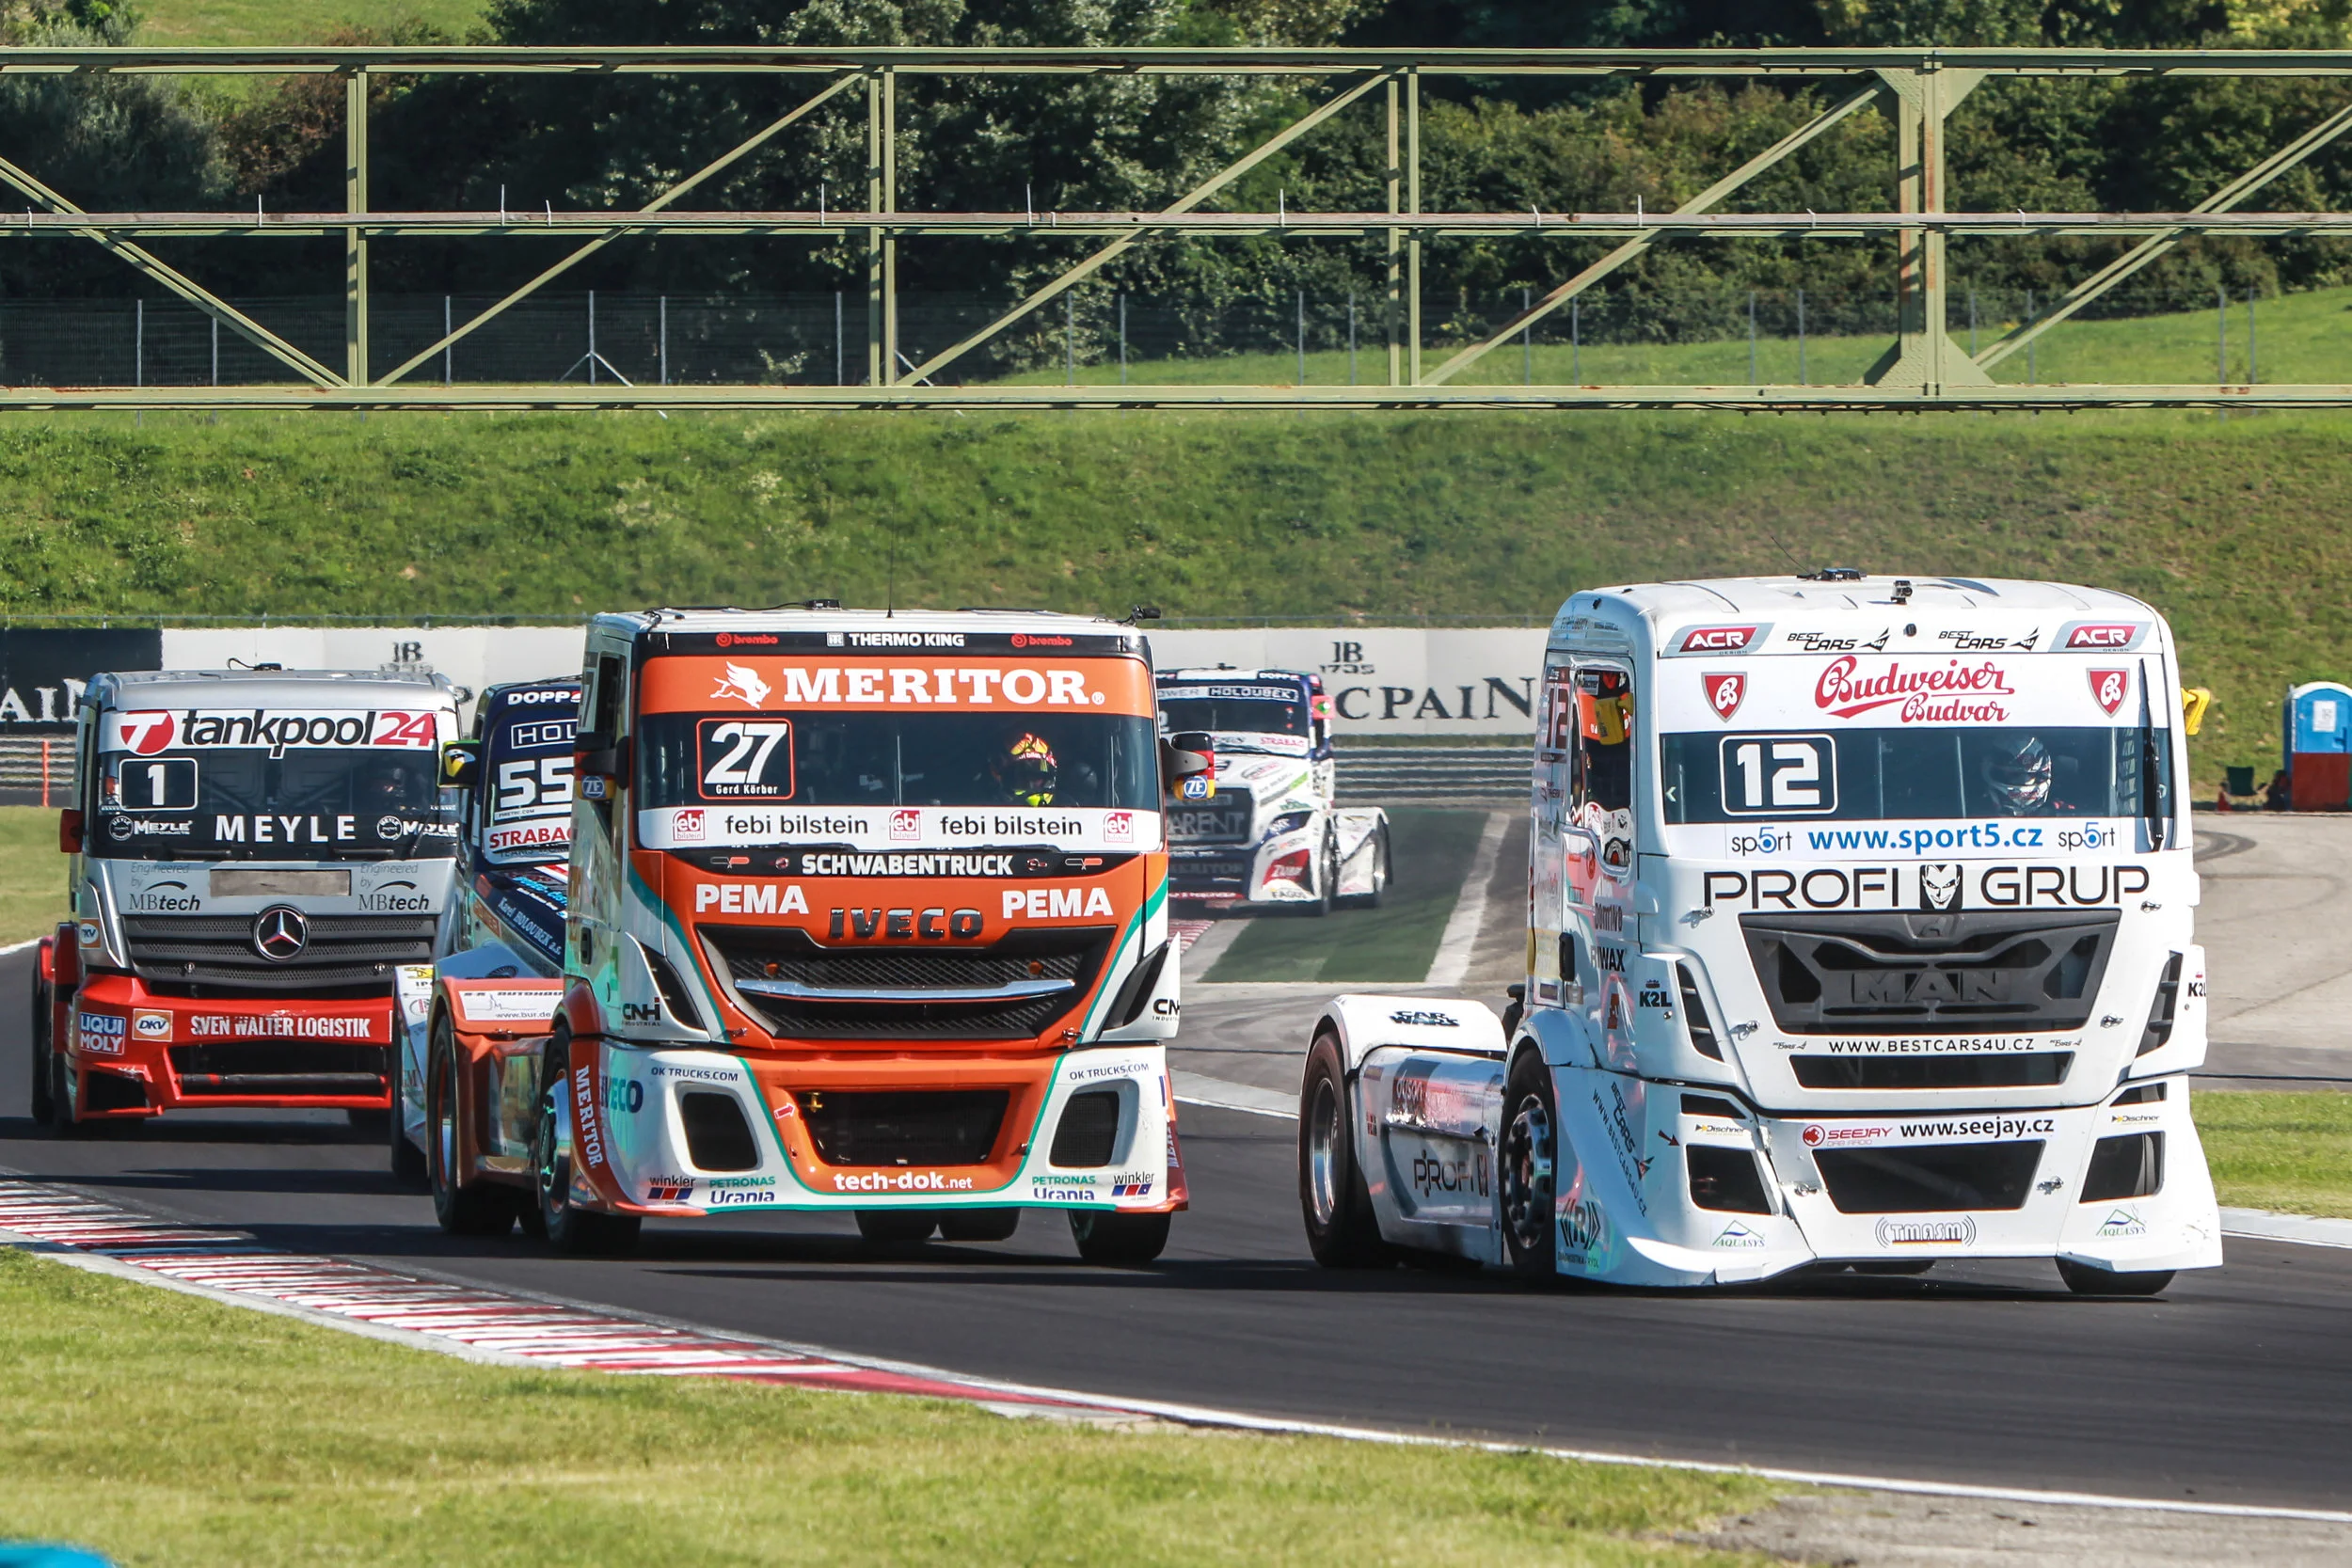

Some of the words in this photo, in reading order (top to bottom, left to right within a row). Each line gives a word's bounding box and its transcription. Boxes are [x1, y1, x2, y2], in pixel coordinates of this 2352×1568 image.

[734, 634, 779, 644] brembo
[849, 633, 921, 646] THERMO
[925, 633, 965, 647] KING
[1028, 636, 1073, 646] brembo
[1690, 631, 1744, 648] ACR
[1787, 632, 1823, 641] BEST
[1938, 631, 1974, 640] BEST
[1955, 638, 2008, 649] CARS
[2074, 629, 2126, 644] ACR
[1804, 640, 1858, 651] CARS
[783, 668, 1089, 705] MERITOR
[1815, 656, 2014, 707] Budweiser
[1210, 688, 1291, 699] HOLOUBEK
[1331, 677, 1535, 721] CPAIN
[1901, 692, 2010, 722] Budvar
[705, 722, 787, 784] 27
[500, 756, 574, 808] 55
[1737, 743, 1820, 807] 12
[147, 764, 165, 805] 1
[716, 784, 739, 795] Gerd
[1185, 778, 1206, 797] ZF
[134, 820, 191, 835] MEYLE
[215, 815, 357, 843] MEYLE
[725, 816, 771, 834] febi
[781, 816, 868, 834] bilstein
[940, 816, 986, 835] febi
[995, 815, 1083, 835] bilstein
[1808, 823, 2042, 855] www.sport5.cz
[131, 863, 188, 876] Engineered
[360, 863, 419, 876] Engineered
[802, 854, 1013, 876] SCHWABENTRUCK
[131, 878, 143, 889] by
[360, 877, 373, 889] by
[1704, 868, 1899, 910] PROFI
[1980, 865, 2150, 905] GRUP
[129, 892, 200, 911] MBtech
[358, 894, 430, 911] MBtech
[696, 884, 809, 914] PEMA
[1002, 887, 1113, 919] PEMA
[830, 908, 983, 939] IVECO
[1851, 971, 2010, 1003] MAN
[1640, 991, 1672, 1007] K2L
[80, 1014, 123, 1035] LIQUI
[138, 1021, 167, 1030] DKV
[191, 1015, 230, 1036] SVEN
[234, 1016, 294, 1037] WALTER
[297, 1017, 370, 1038] LOGISTIK
[80, 1034, 123, 1053] MOLY
[1829, 1037, 2034, 1053] WWW.BESTCARS4U.CZ
[651, 1067, 665, 1076] OK
[668, 1068, 739, 1081] TRUCKS.COM
[1070, 1070, 1085, 1080] OK
[1089, 1063, 1150, 1078] TRUCKS.COM
[576, 1065, 603, 1166] MERITOR
[1828, 1128, 1893, 1139] SEEJAY
[1900, 1117, 2055, 1139] www.seejay.cz
[650, 1176, 695, 1189] winkler
[709, 1176, 776, 1189] PETRONAS
[834, 1171, 973, 1190] tech-dok.net
[1032, 1175, 1096, 1185] PETRONAS
[1114, 1171, 1155, 1185] winkler
[710, 1189, 775, 1205] Urania
[1034, 1186, 1095, 1201] Urania
[2100, 1226, 2147, 1236] AQUASYS
[1716, 1238, 1766, 1248] AQUASYS
